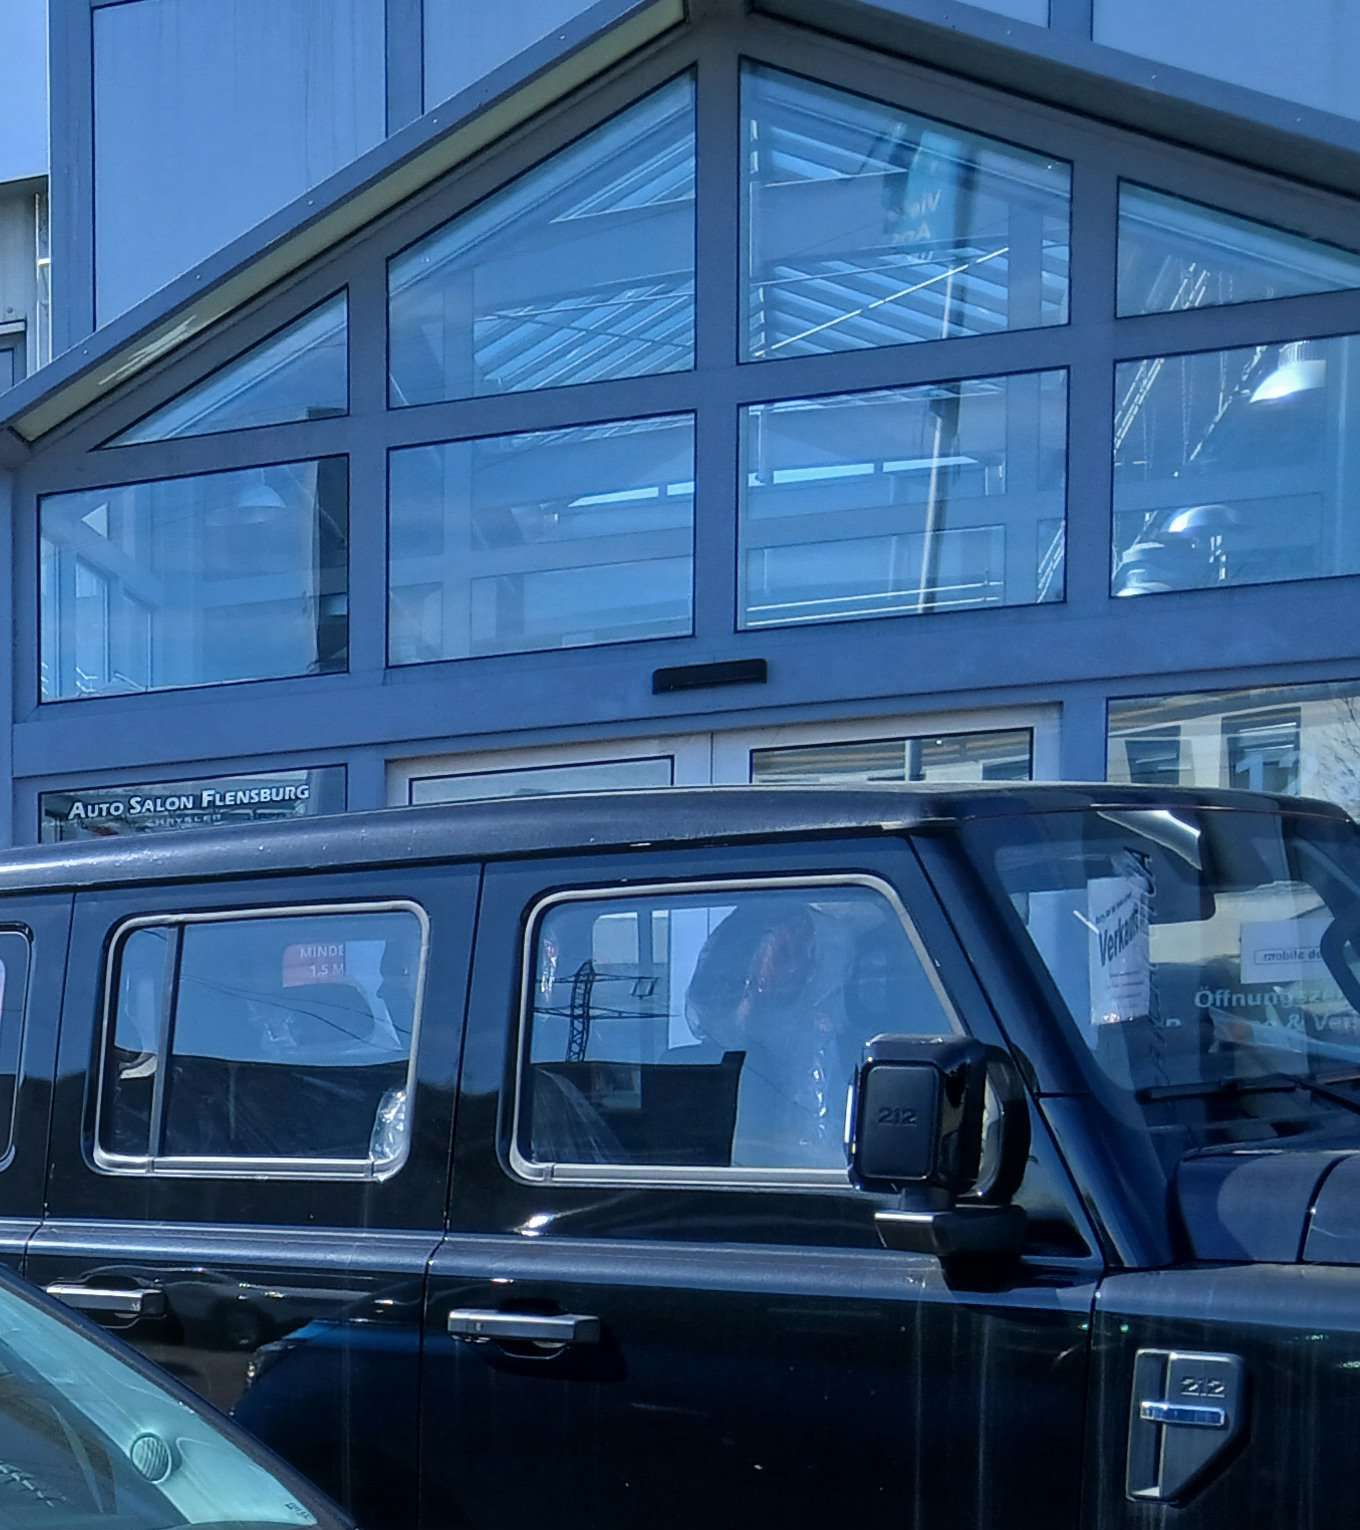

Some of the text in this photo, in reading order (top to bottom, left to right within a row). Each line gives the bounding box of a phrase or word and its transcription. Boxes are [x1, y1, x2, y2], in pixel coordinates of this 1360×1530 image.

[300, 943, 345, 958] MINDE
[878, 1106, 918, 1126] 212
[1180, 1376, 1225, 1398] 212
